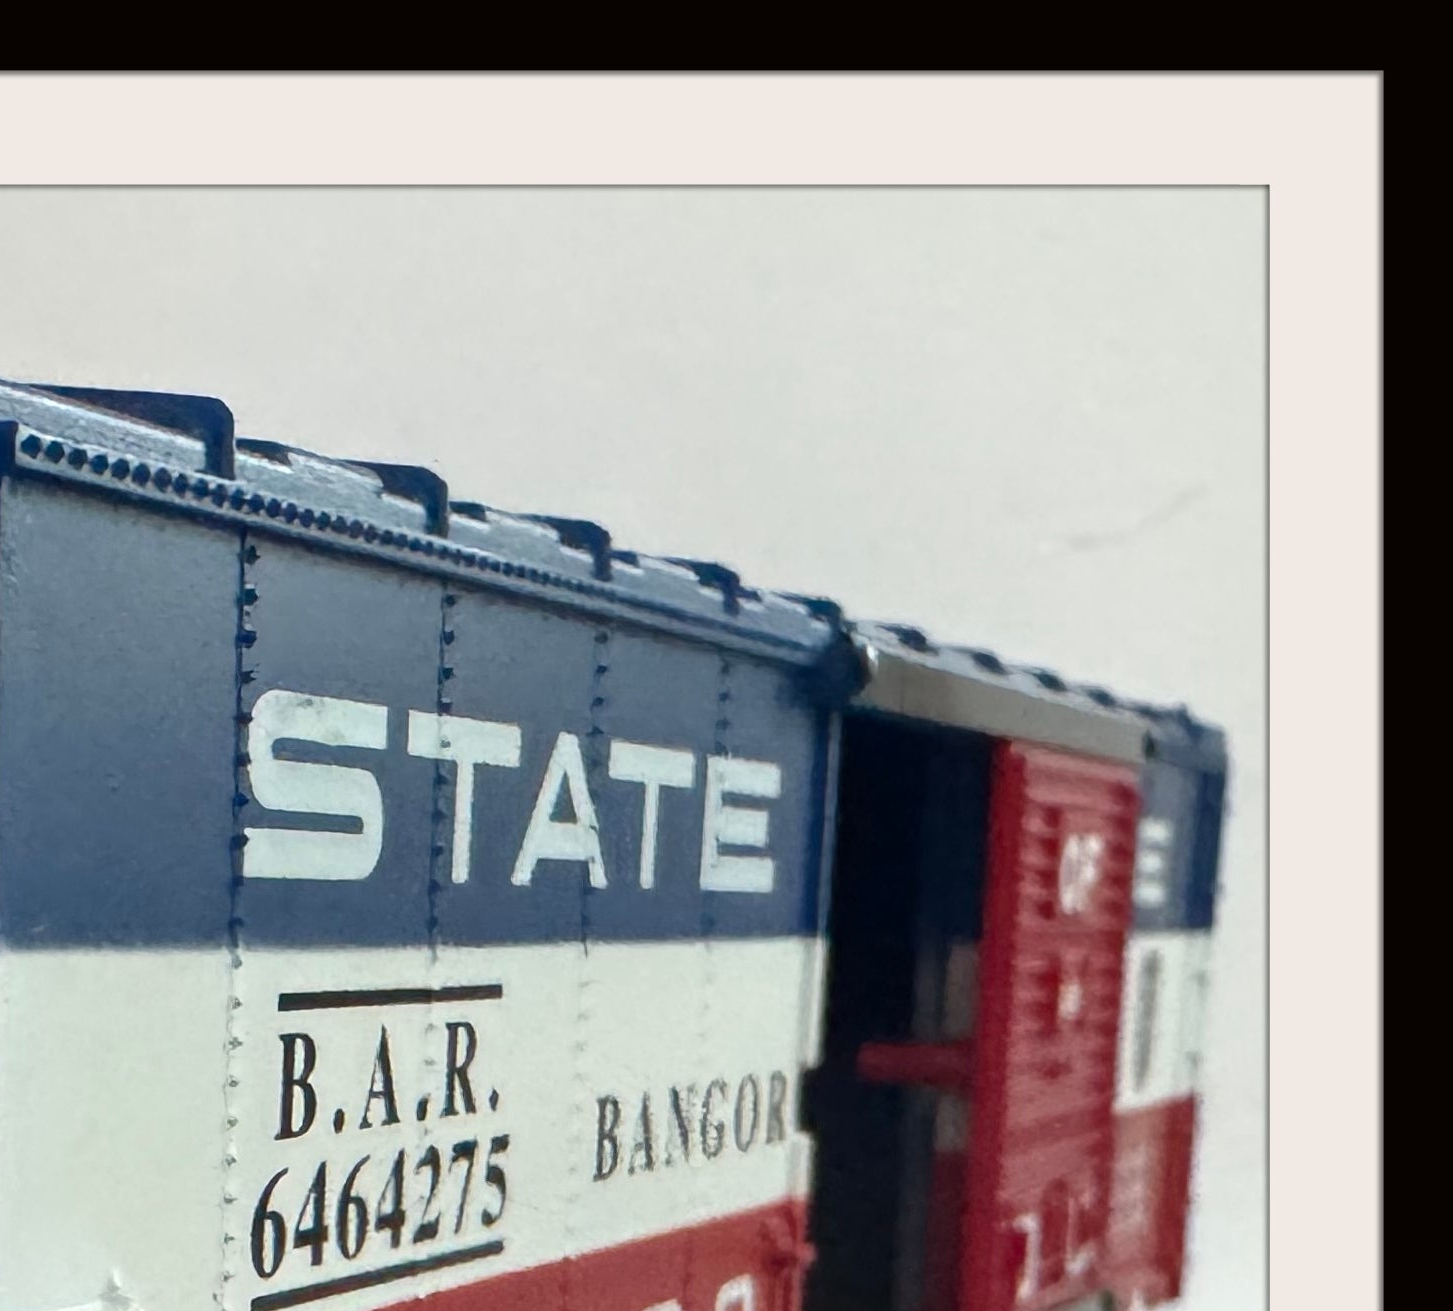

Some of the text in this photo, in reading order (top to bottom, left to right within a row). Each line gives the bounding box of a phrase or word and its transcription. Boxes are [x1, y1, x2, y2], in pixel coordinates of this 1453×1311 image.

[242, 689, 782, 893] STATE
[274, 1021, 500, 1141] B.A.R.
[593, 1069, 788, 1183] BANGOR
[250, 1134, 510, 1279] 6464275
